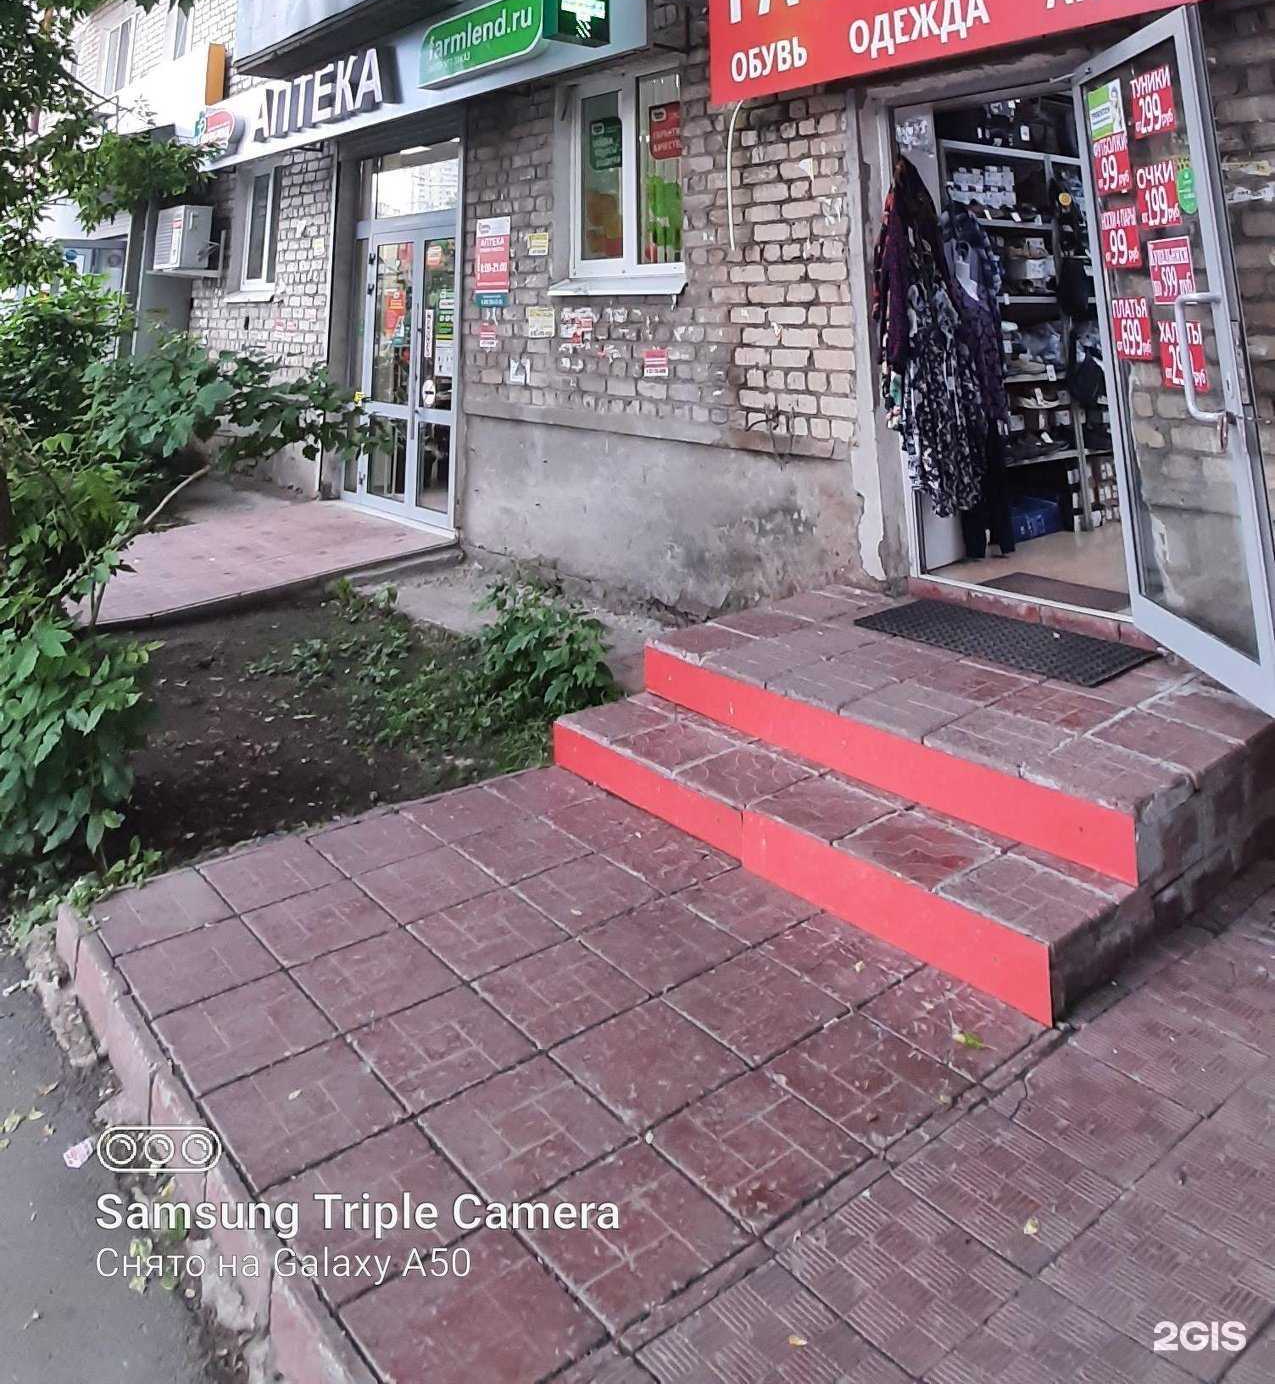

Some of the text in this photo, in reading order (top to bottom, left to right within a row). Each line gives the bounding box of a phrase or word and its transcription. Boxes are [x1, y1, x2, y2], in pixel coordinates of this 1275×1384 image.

[428, 6, 532, 61] farmlend.ru
[731, 35, 808, 83] ОБУВЬ
[252, 48, 383, 140] АПТЕКА
[1130, 65, 1171, 98] ТУНИКИ
[1139, 93, 1161, 133] 299
[1101, 155, 1118, 190] 99
[1136, 160, 1175, 189] ОЧКИ
[1145, 186, 1168, 226] 199
[1110, 229, 1128, 265] 99
[1161, 265, 1178, 296] 599
[1112, 298, 1147, 318] ПЛАТЬЯ
[1121, 319, 1142, 356] 699
[1158, 321, 1202, 344] ХАЛТЫ
